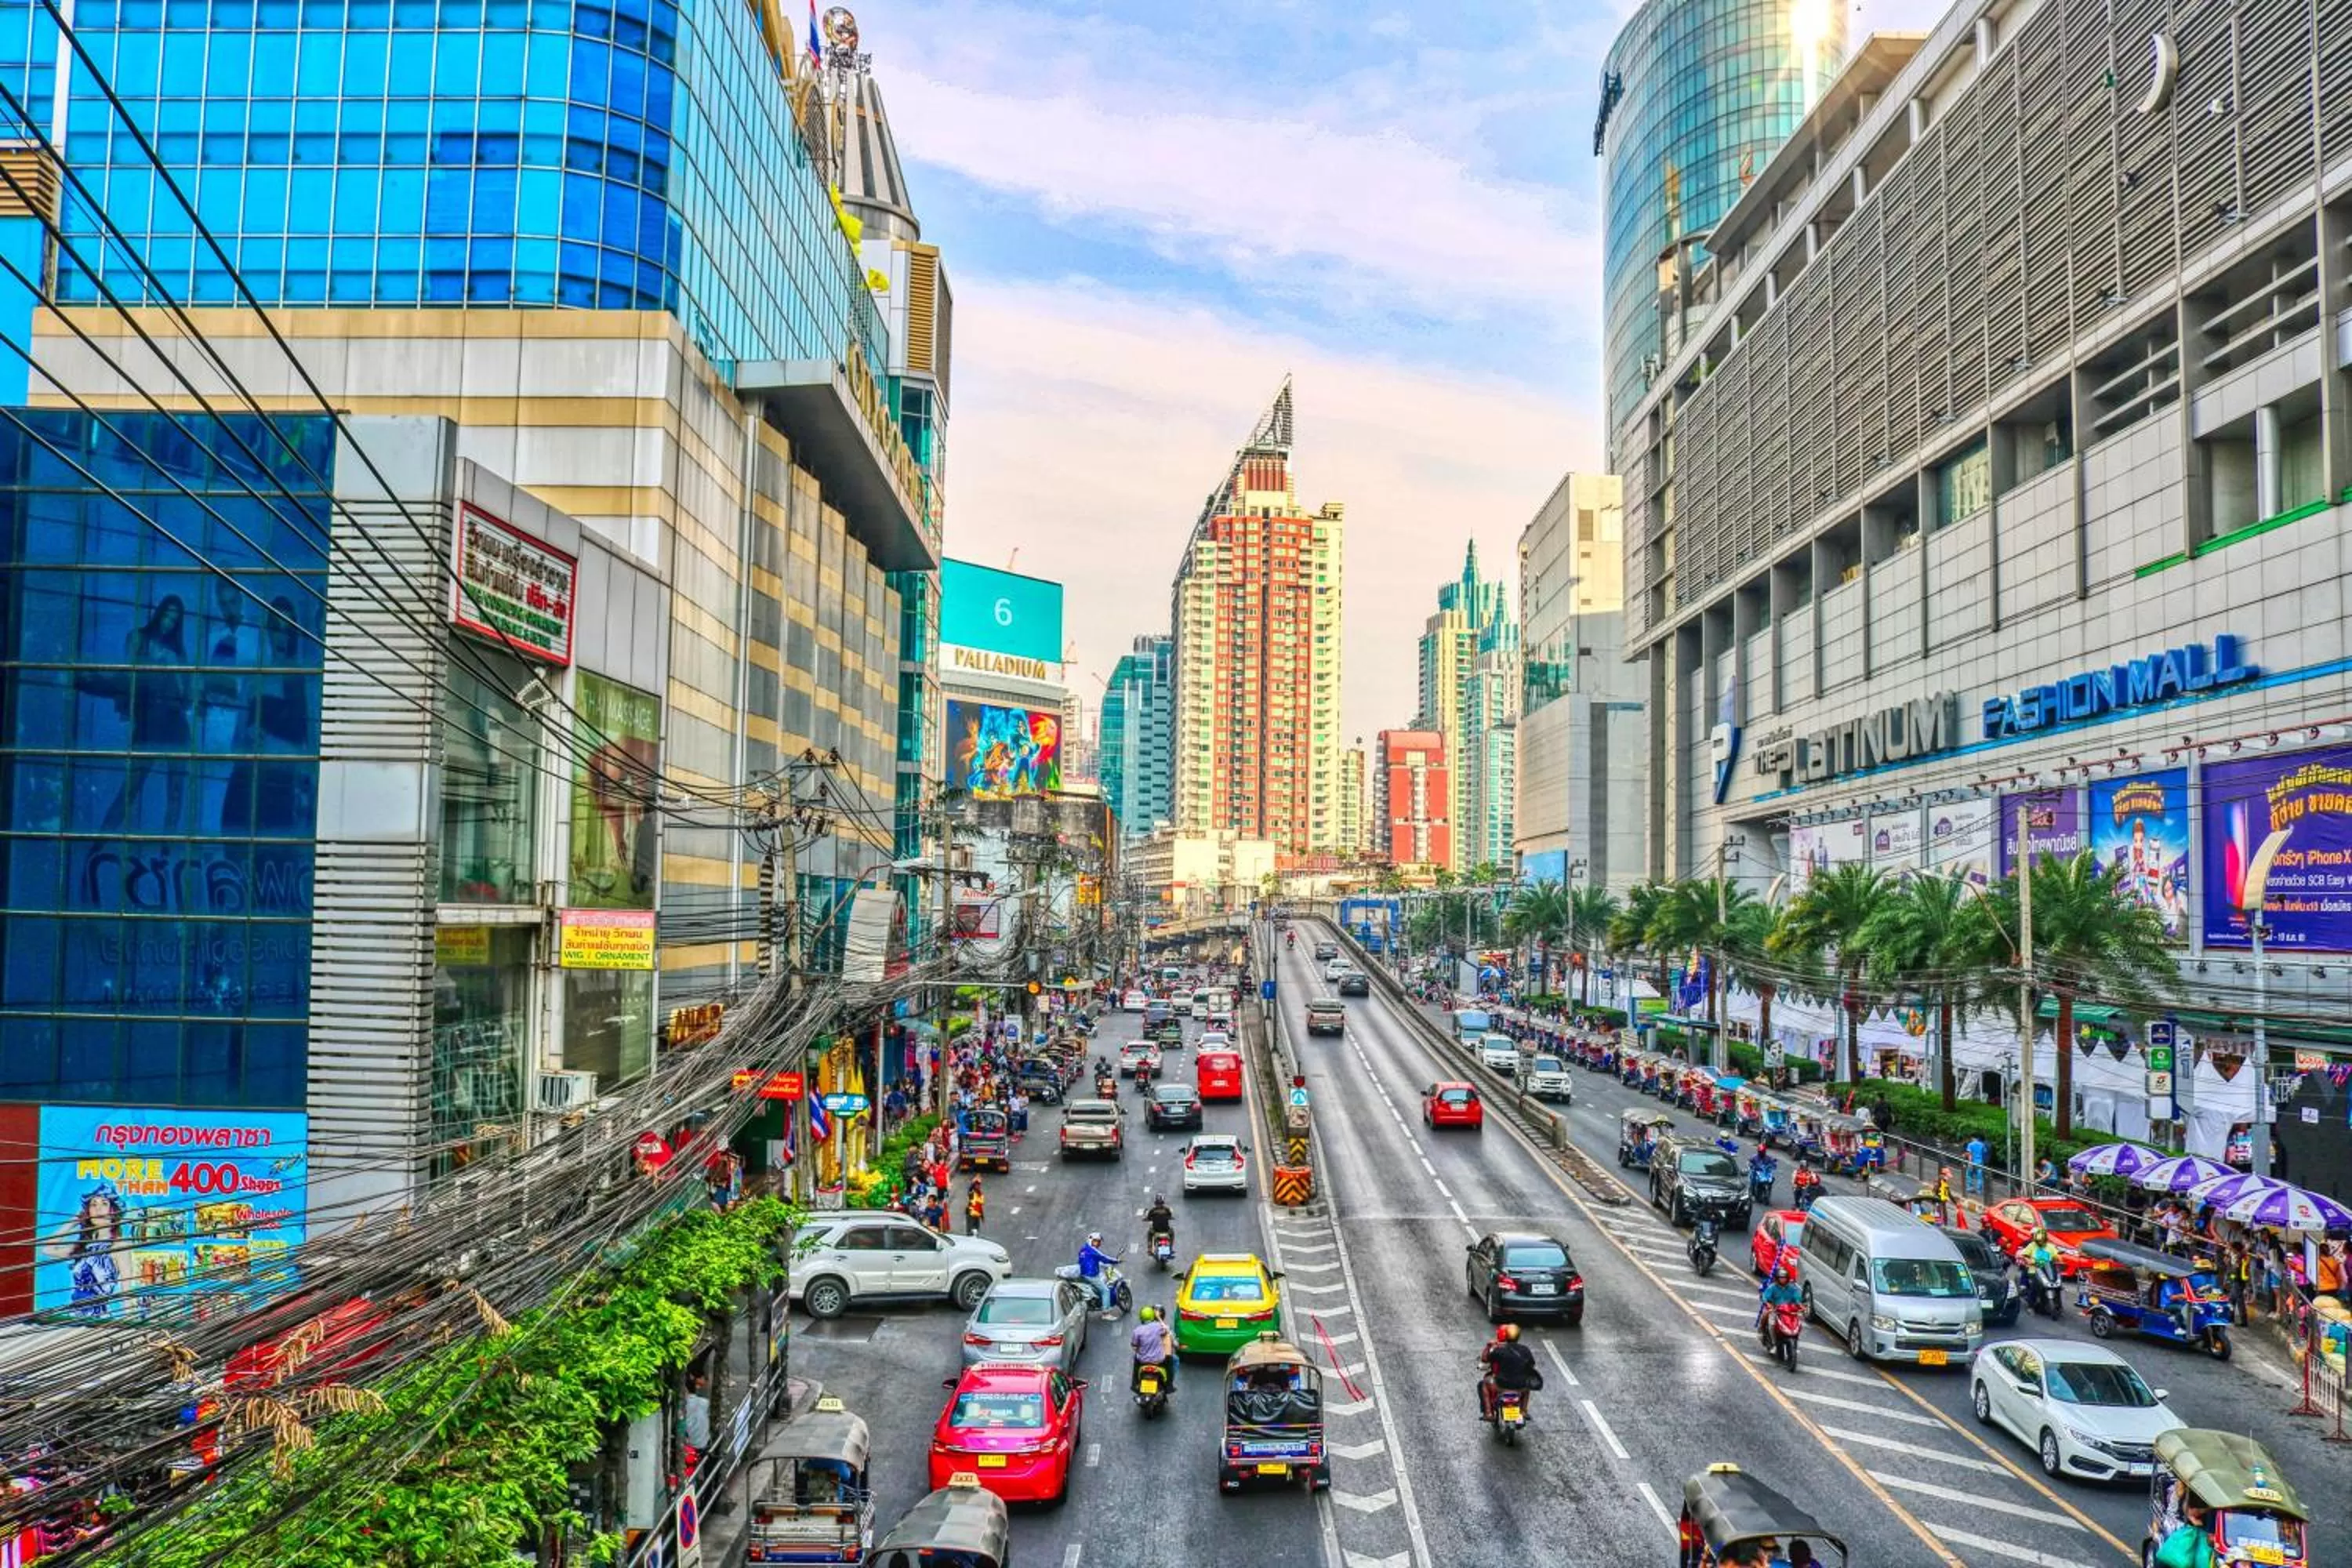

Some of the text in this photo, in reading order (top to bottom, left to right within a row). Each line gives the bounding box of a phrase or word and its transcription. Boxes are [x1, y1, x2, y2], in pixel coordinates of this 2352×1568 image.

[994, 598, 1012, 626] 6
[954, 647, 1047, 681] PALLADIUM
[1983, 634, 2260, 739] FASHION MALL
[608, 697, 652, 732] MASSAGE
[1753, 750, 1777, 775] THE
[2307, 874, 2325, 886] SCB
[595, 951, 650, 960] ORNAMENT
[77, 1159, 164, 1180] MORE
[169, 1161, 240, 1195] 400
[115, 1179, 169, 1195] THAN
